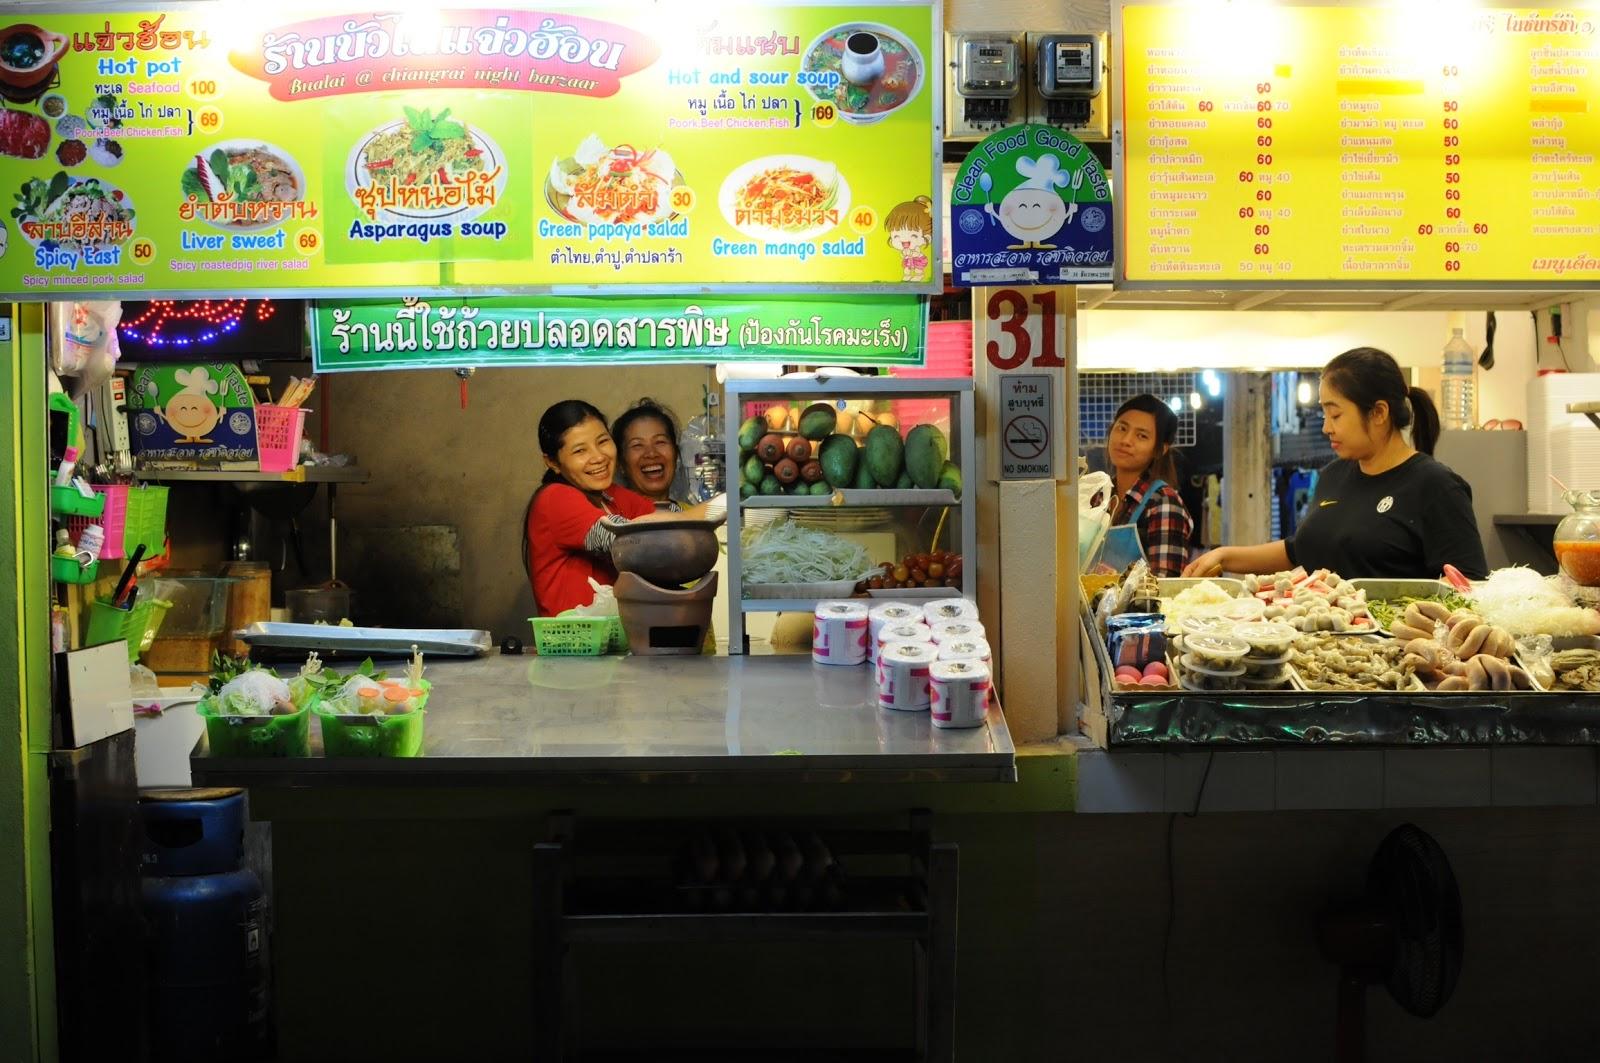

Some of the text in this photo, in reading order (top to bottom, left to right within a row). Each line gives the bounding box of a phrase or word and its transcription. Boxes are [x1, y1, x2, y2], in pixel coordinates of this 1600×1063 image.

[99, 56, 182, 77] Hot pot
[1443, 65, 1458, 77] 60
[290, 64, 600, 95] Bualai @ chiangrai night barzaar
[668, 68, 840, 88] Hot and sour soup
[95, 81, 216, 95] ทะเล Seafood 100
[1256, 82, 1271, 94] 60
[688, 97, 707, 115] หมู
[713, 89, 735, 110] เนื้อ
[740, 91, 756, 109] ไก่
[762, 96, 788, 110] ปลา
[1199, 100, 1213, 112] 60
[1257, 100, 1272, 112] 60
[1443, 100, 1458, 112] 50
[92, 100, 218, 126] หมู เนื้อ ไก่ ปลา 69
[1257, 117, 1272, 129] 60
[1443, 118, 1458, 129] 60
[1257, 135, 1272, 147] 60
[1444, 135, 1459, 147] 50
[955, 129, 1108, 202] Clean Food Good Taste
[1257, 153, 1272, 165] 60
[1445, 154, 1460, 165] 50
[1239, 171, 1254, 182] 60
[1277, 173, 1290, 182] 40
[1445, 172, 1460, 183] 50
[355, 166, 501, 220] ซุปหน่อไม้
[673, 192, 691, 206] 30
[1256, 190, 1272, 201] 60
[1445, 189, 1460, 200] 60
[179, 192, 317, 220] ยำตับหวาน
[1239, 206, 1254, 218] 60
[1278, 208, 1291, 217] 40
[855, 212, 872, 226] 40
[1446, 207, 1461, 219] 60
[29, 212, 133, 239] ลาบอีสาน
[350, 220, 507, 241] Asparagus soup
[539, 218, 688, 241] Green papaya salad
[1254, 224, 1270, 235] 60
[1418, 224, 1433, 235] 60
[1473, 223, 1488, 234] 60
[182, 229, 317, 249] Liver sweet 69
[713, 238, 864, 260] Green mango salad
[1254, 243, 1269, 255] 60
[1445, 241, 1460, 252] 60
[35, 244, 152, 270] Spicy East 50
[954, 244, 1109, 268] อาหารสะอาด รสชาติอร่อย
[170, 258, 308, 272] Spicy roastedpig river salad
[1239, 262, 1254, 271] 50
[1278, 262, 1291, 271] 40
[1445, 260, 1460, 271] 60
[23, 273, 144, 286] Spicy minced pork salad
[986, 289, 1065, 370] 31
[225, 368, 249, 405] Taste
[1012, 381, 1037, 394] ห้าม
[1007, 394, 1044, 411] สูบบุหรี่
[1004, 464, 1049, 473] NO SMOKING
